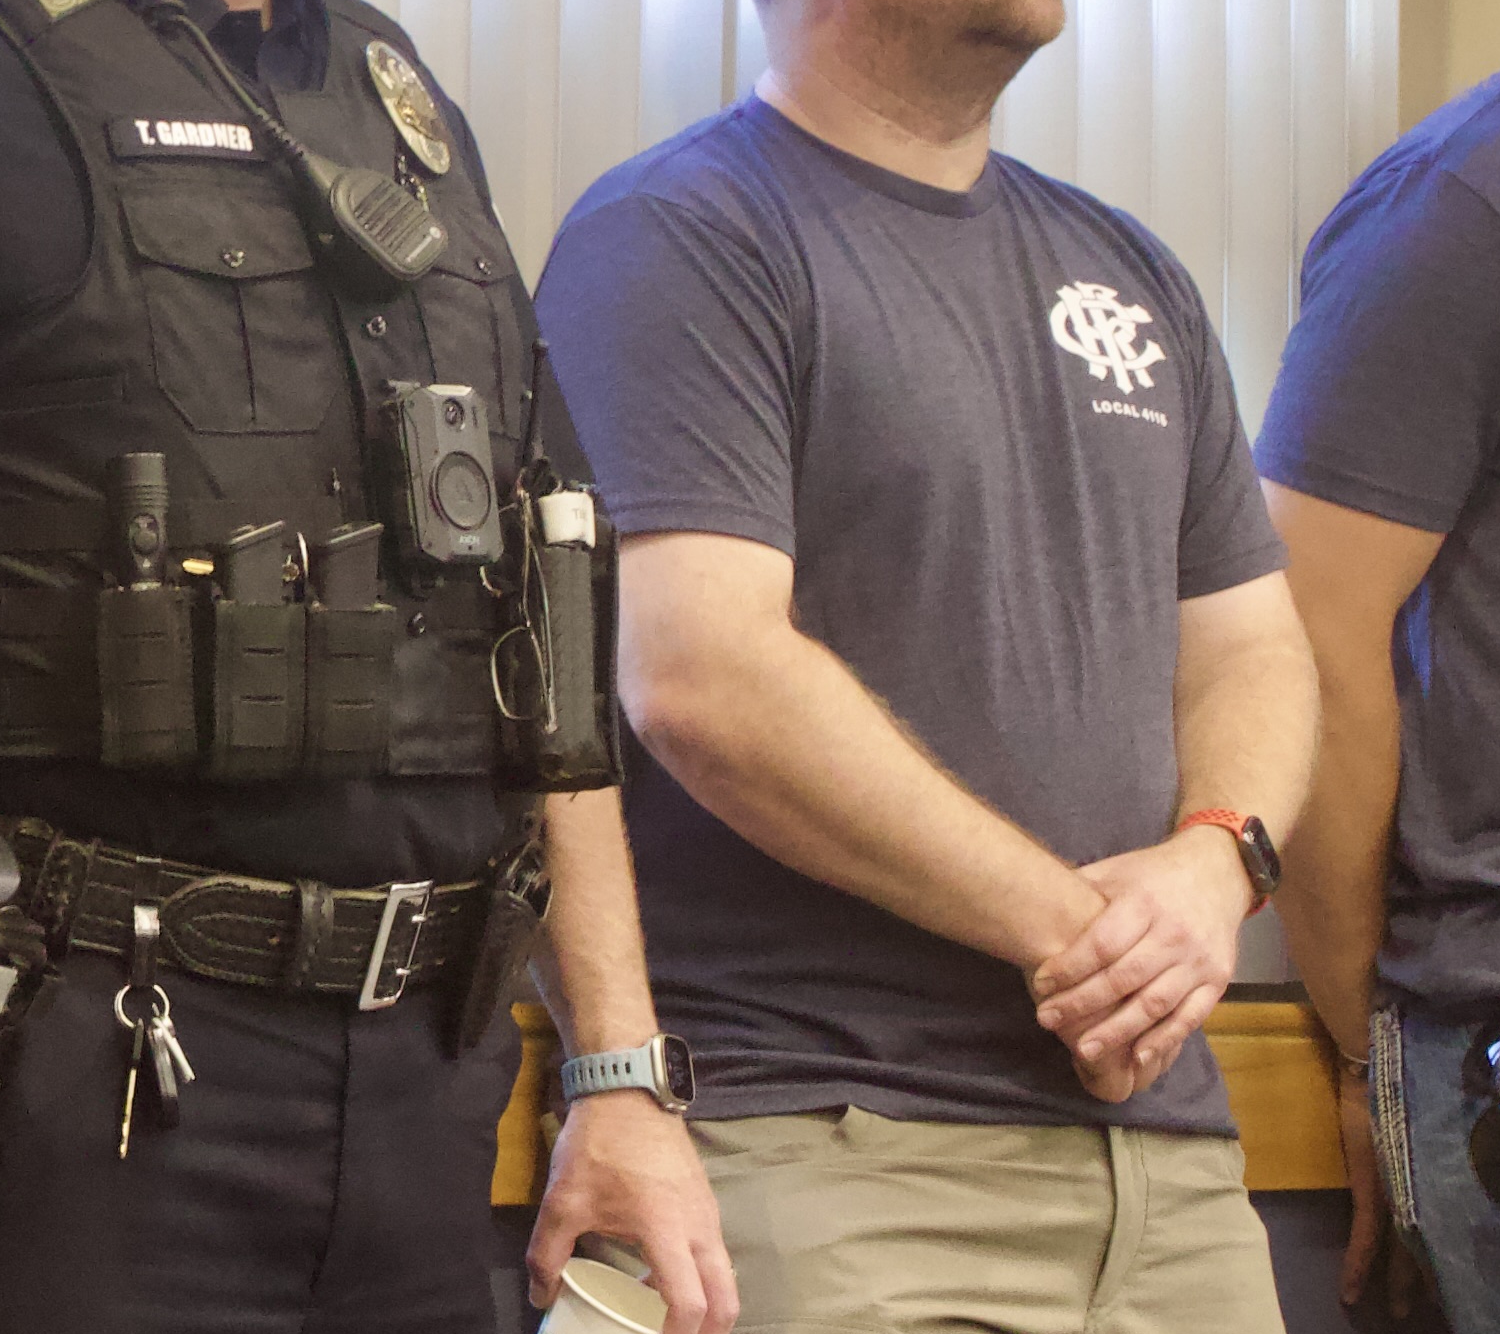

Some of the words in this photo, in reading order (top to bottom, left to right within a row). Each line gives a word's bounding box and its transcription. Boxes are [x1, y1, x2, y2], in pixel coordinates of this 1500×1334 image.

[133, 119, 156, 146] T.
[155, 120, 254, 153] GARDNER
[1091, 399, 1141, 419] LOCAL
